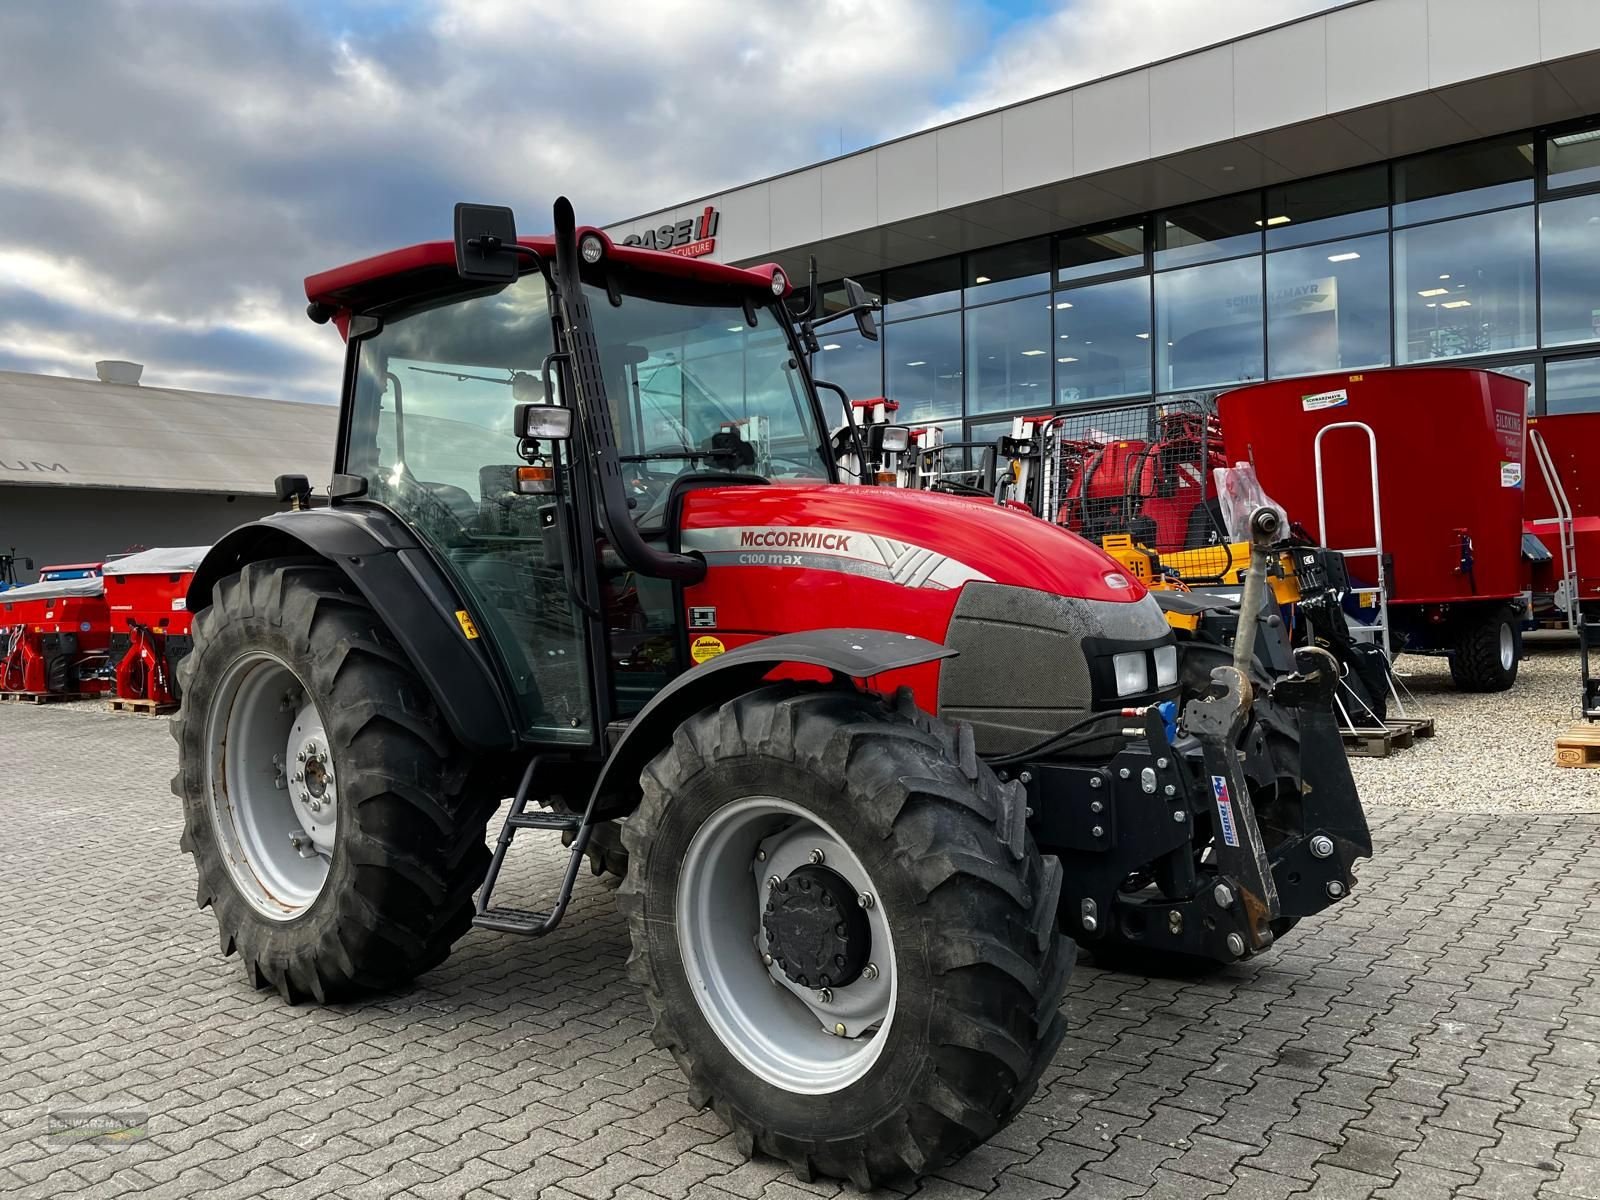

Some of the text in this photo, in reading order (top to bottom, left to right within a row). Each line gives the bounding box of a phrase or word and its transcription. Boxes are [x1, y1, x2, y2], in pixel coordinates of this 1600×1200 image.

[740, 531, 852, 551] McCORMICK
[740, 554, 803, 565] C100 max
